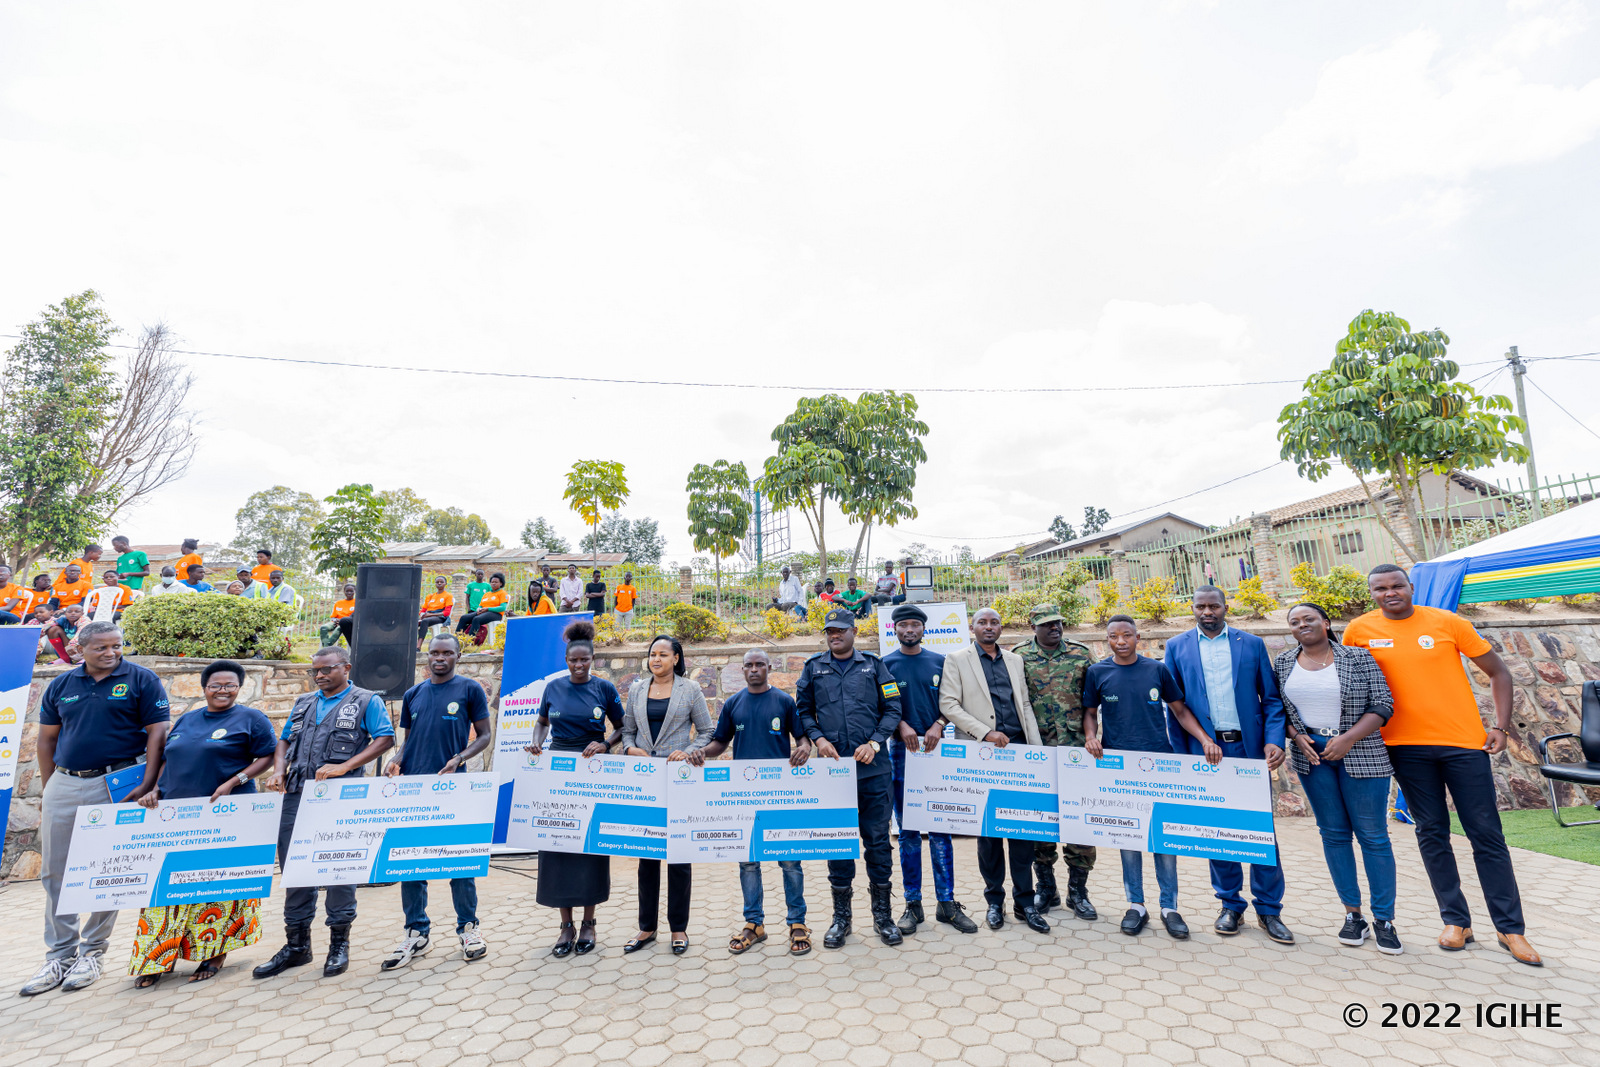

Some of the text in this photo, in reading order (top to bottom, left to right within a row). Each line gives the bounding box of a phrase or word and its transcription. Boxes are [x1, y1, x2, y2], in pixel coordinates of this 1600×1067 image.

[505, 698, 540, 706] UMUNSI
[986, 770, 1027, 779] COMPETITION
[971, 777, 999, 785] FRIENDLY
[1115, 779, 1148, 788] BUSINESS
[1149, 782, 1197, 792] COMPETITION
[565, 781, 593, 789] BUSINESS
[594, 783, 635, 792] COMPETITION
[579, 790, 606, 798] FRIENDLY
[607, 792, 633, 800] CENTERS
[634, 794, 656, 802] AWARD
[721, 790, 751, 798] BUSINESS
[1132, 789, 1165, 798] FRIENDLY
[1166, 792, 1197, 801] CENTERS
[1198, 794, 1226, 803] AWARD
[177, 805, 203, 813] GENERATION
[354, 808, 385, 816] BUSINESS
[386, 806, 432, 815] COMPETITION
[931, 803, 956, 812] 800,000
[178, 812, 200, 820] UNLIMITED
[1090, 816, 1117, 825] 800,000
[536, 819, 560, 827] 800,000
[995, 825, 1021, 834] Category:
[131, 832, 164, 841] BUSINESS
[165, 829, 212, 838] COMPETITION
[1249, 834, 1273, 842] District
[147, 840, 179, 848] FRIENDLY
[180, 837, 211, 846] CENTERS
[211, 835, 237, 843] AWARD
[597, 841, 623, 849] Category:
[623, 843, 646, 851] Business
[815, 847, 852, 855] Improvement
[1163, 842, 1267, 858] Category: Business Improvement
[318, 851, 362, 861] 800,000 Rwfs
[441, 864, 481, 872] Improvement
[95, 877, 124, 887] 800,000
[166, 891, 196, 899] Category:
[222, 886, 263, 895] Improvement
